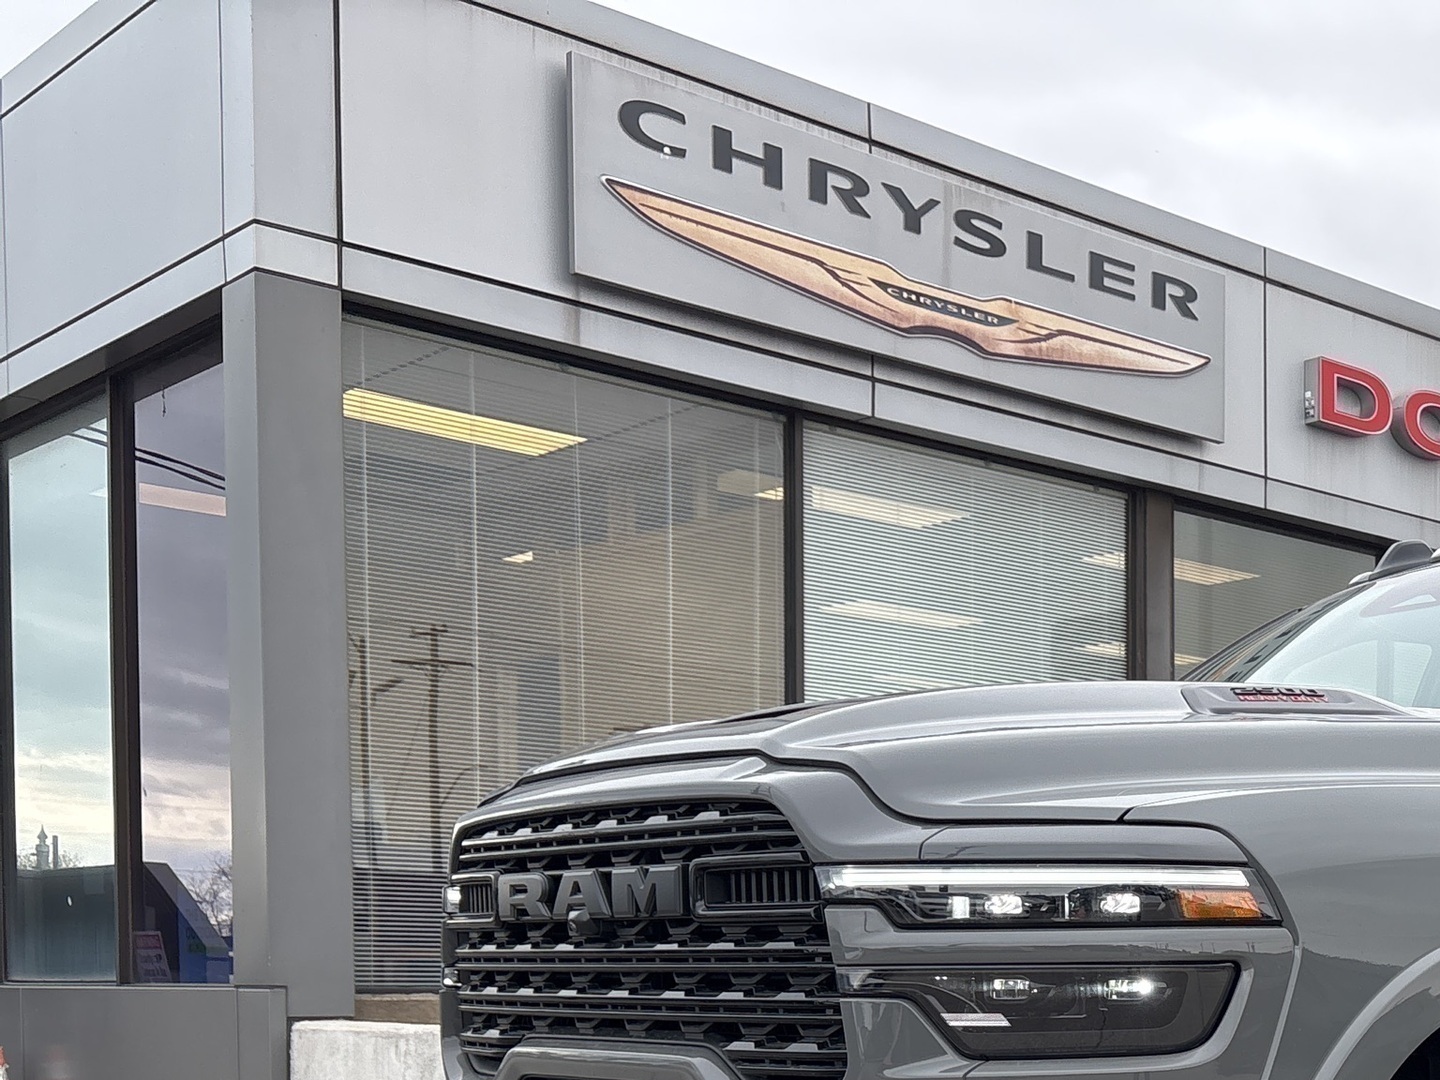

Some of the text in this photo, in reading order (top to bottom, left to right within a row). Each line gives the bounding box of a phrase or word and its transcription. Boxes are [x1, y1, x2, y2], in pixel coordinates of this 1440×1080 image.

[617, 98, 1199, 322] CHRYSLER
[886, 287, 999, 325] CHRYSLER
[499, 863, 684, 922] RAM
